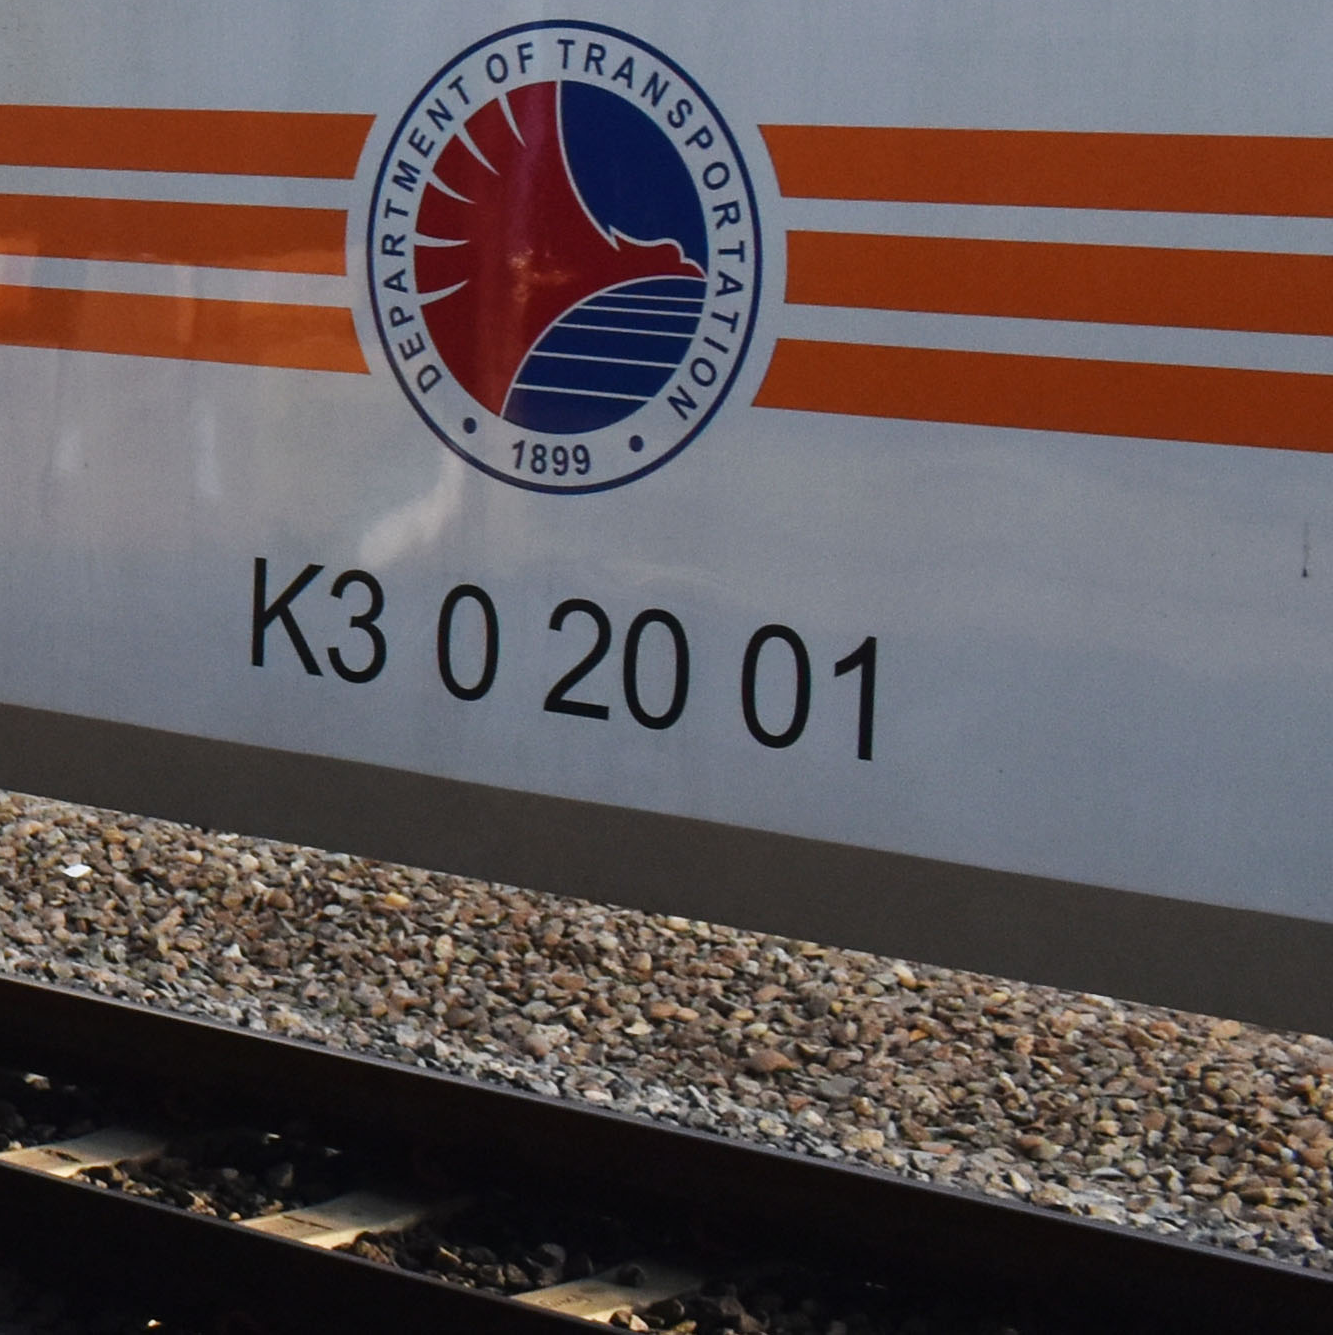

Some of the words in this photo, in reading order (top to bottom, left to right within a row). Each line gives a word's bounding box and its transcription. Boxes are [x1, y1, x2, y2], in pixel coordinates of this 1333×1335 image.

[381, 74, 473, 395] DEPARTMENT
[485, 41, 535, 85] OF
[556, 38, 746, 422] TRANSPORTATION
[511, 439, 592, 476] 1899
[250, 556, 387, 684] K3
[437, 583, 500, 702] 0
[542, 597, 690, 730] 20
[740, 623, 877, 762] 01
